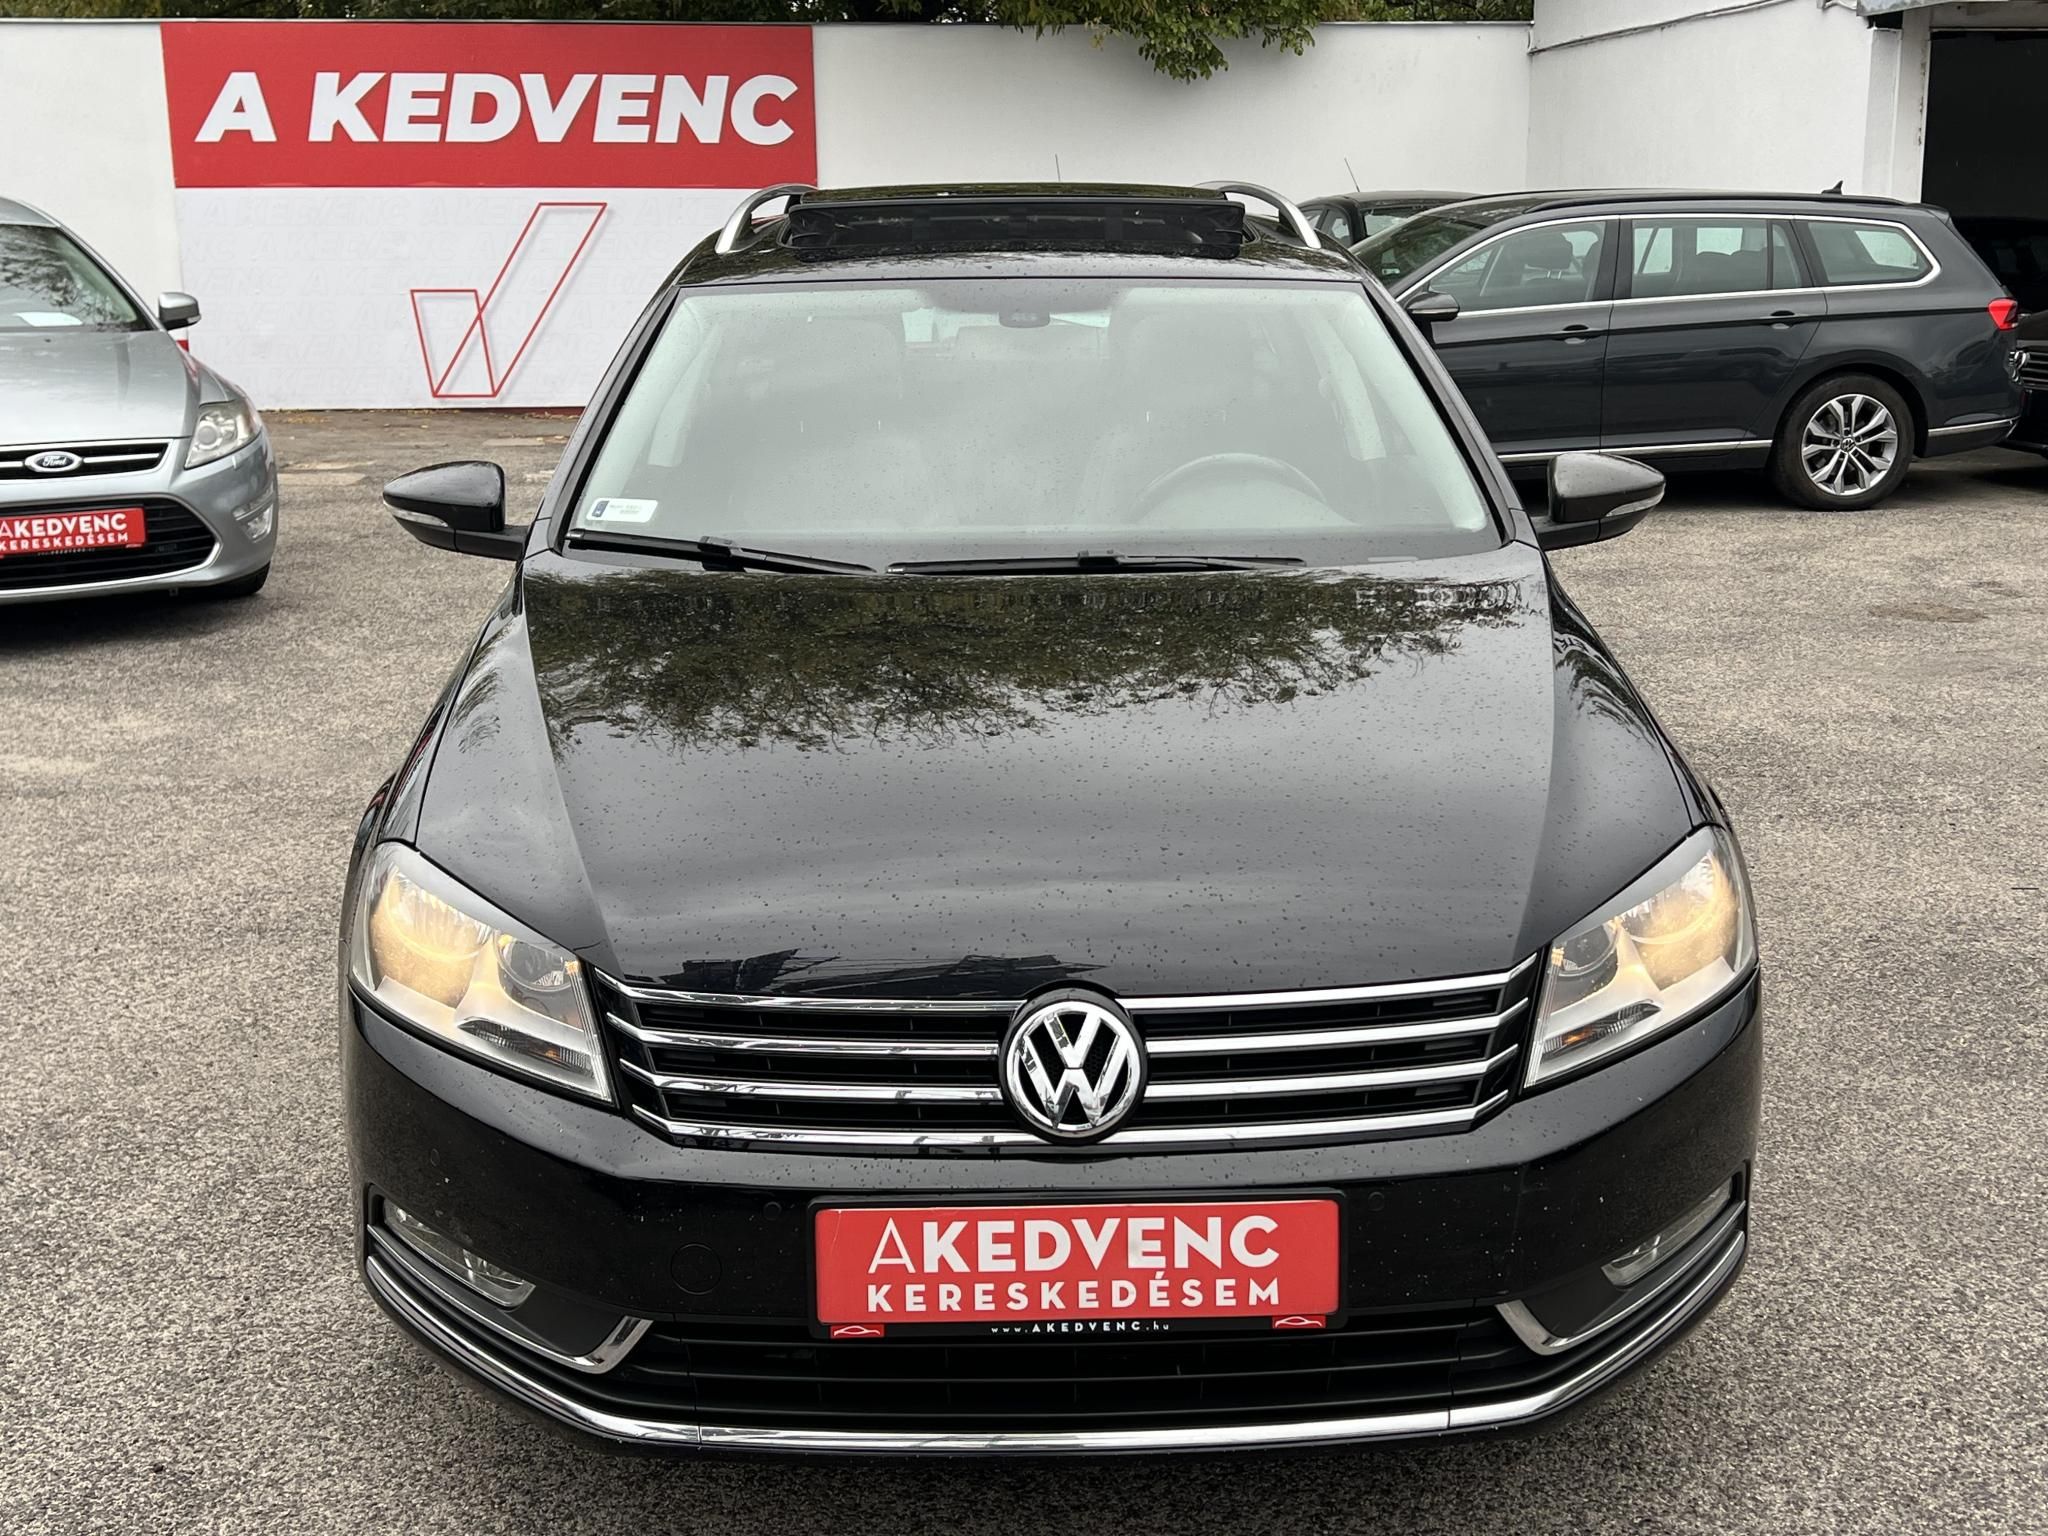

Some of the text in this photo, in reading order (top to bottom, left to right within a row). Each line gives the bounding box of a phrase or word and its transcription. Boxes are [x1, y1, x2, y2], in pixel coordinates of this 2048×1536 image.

[194, 71, 799, 146] A KEDVENC
[867, 1270, 1279, 1312] KERESKEDÉSEM
